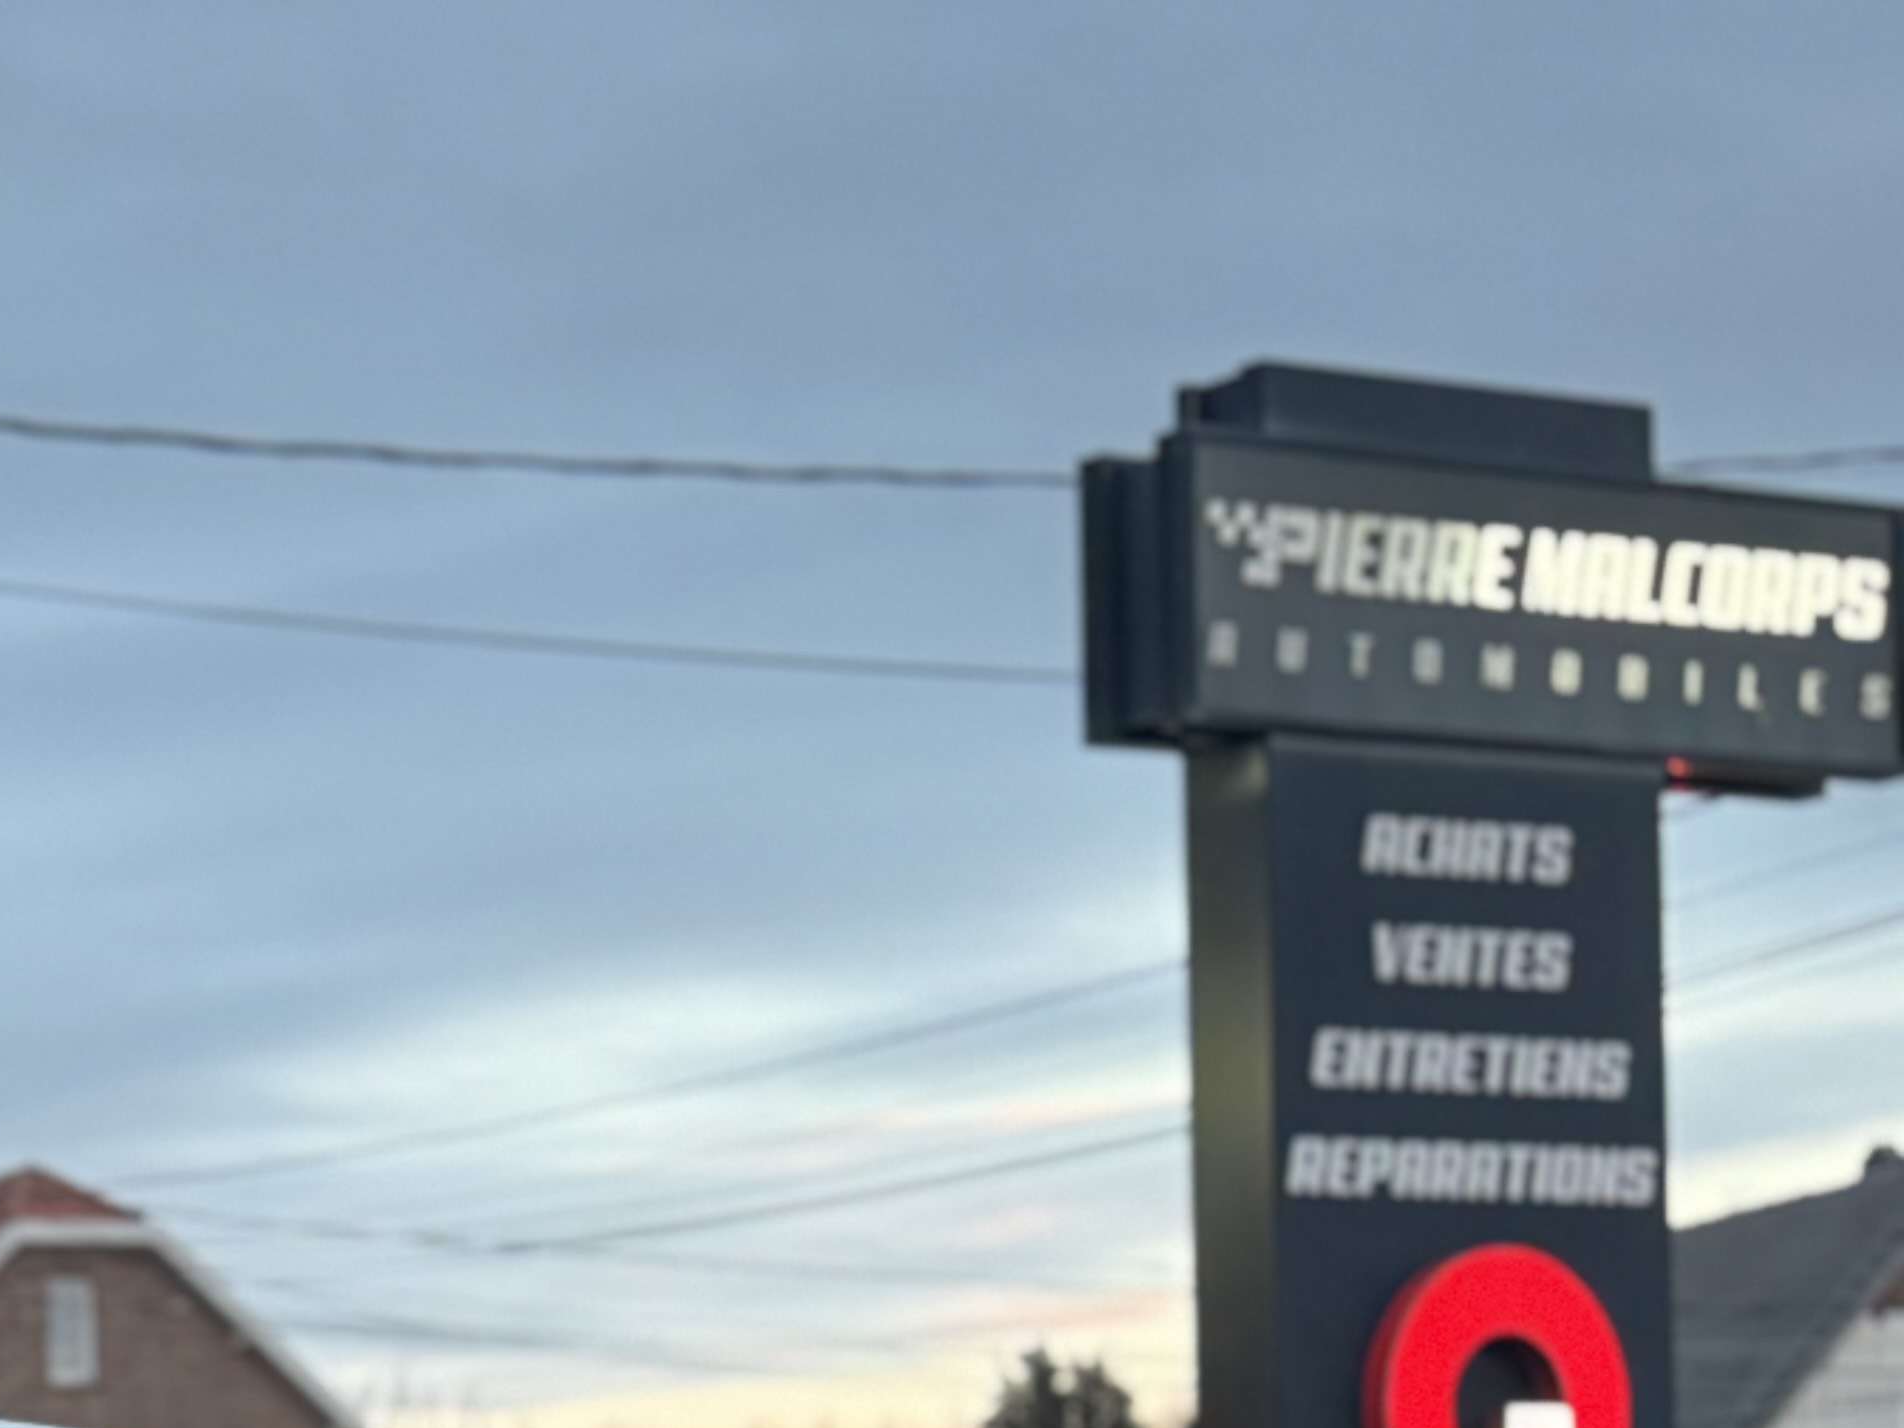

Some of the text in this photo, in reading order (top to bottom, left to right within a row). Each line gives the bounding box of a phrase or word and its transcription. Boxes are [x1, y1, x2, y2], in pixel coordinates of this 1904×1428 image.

[1242, 503, 1890, 641] PIERRE MALCORPS
[1207, 621, 1892, 721] AUTOMOBILES
[1361, 812, 1573, 885] ACHATS
[1372, 922, 1572, 992] VENTES
[1309, 1026, 1632, 1099] ENTRETIENS
[1286, 1133, 1659, 1207] REPARATIONS
